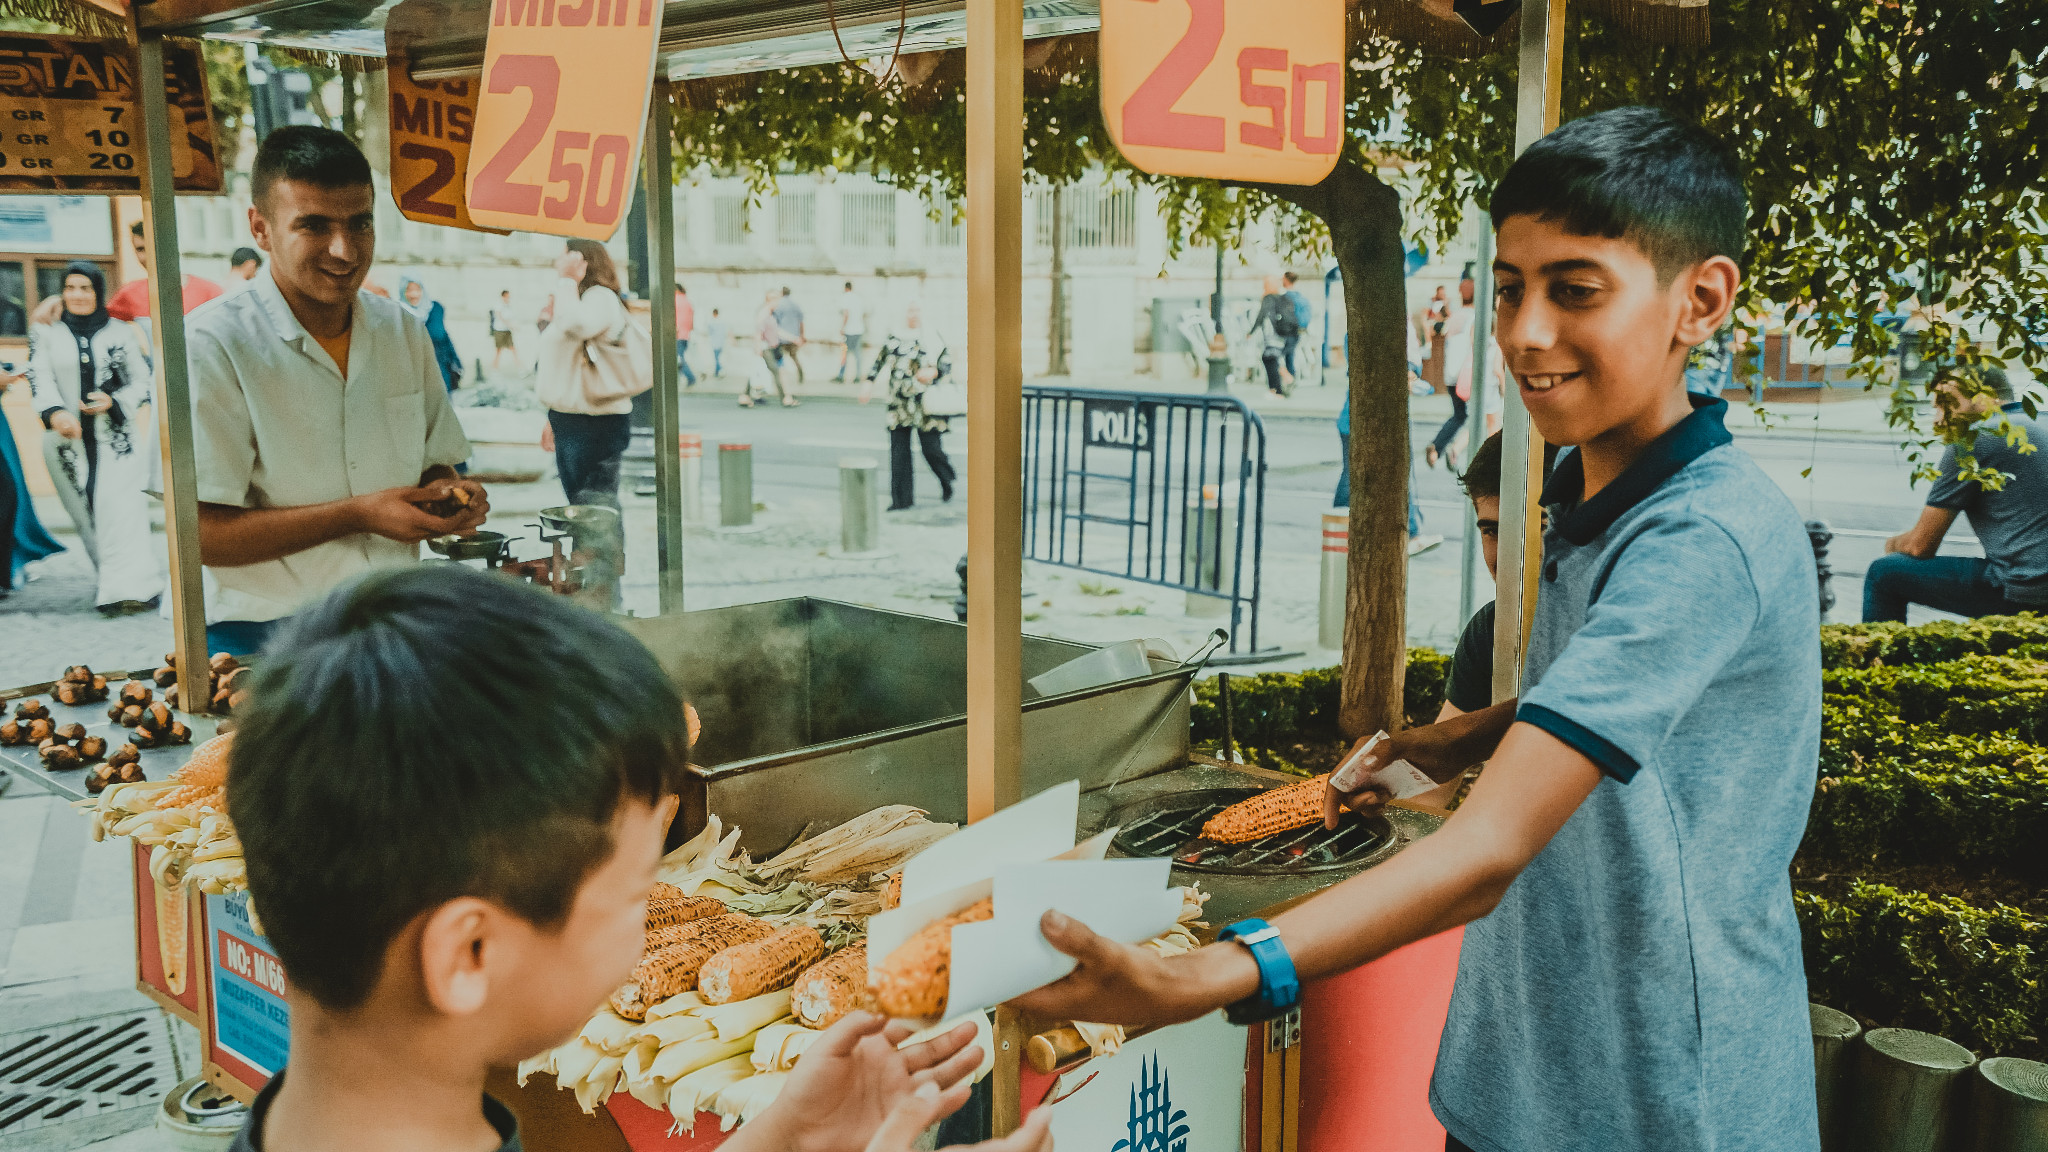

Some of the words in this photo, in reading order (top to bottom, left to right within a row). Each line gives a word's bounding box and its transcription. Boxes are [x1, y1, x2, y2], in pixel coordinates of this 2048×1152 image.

[11, 109, 47, 122] GR
[103, 106, 125, 124] 7
[16, 133, 50, 146] GR
[85, 129, 130, 147] 10
[21, 157, 54, 169] GR
[87, 153, 134, 170] 20
[227, 938, 252, 978] NO:
[254, 952, 286, 995] M/66
